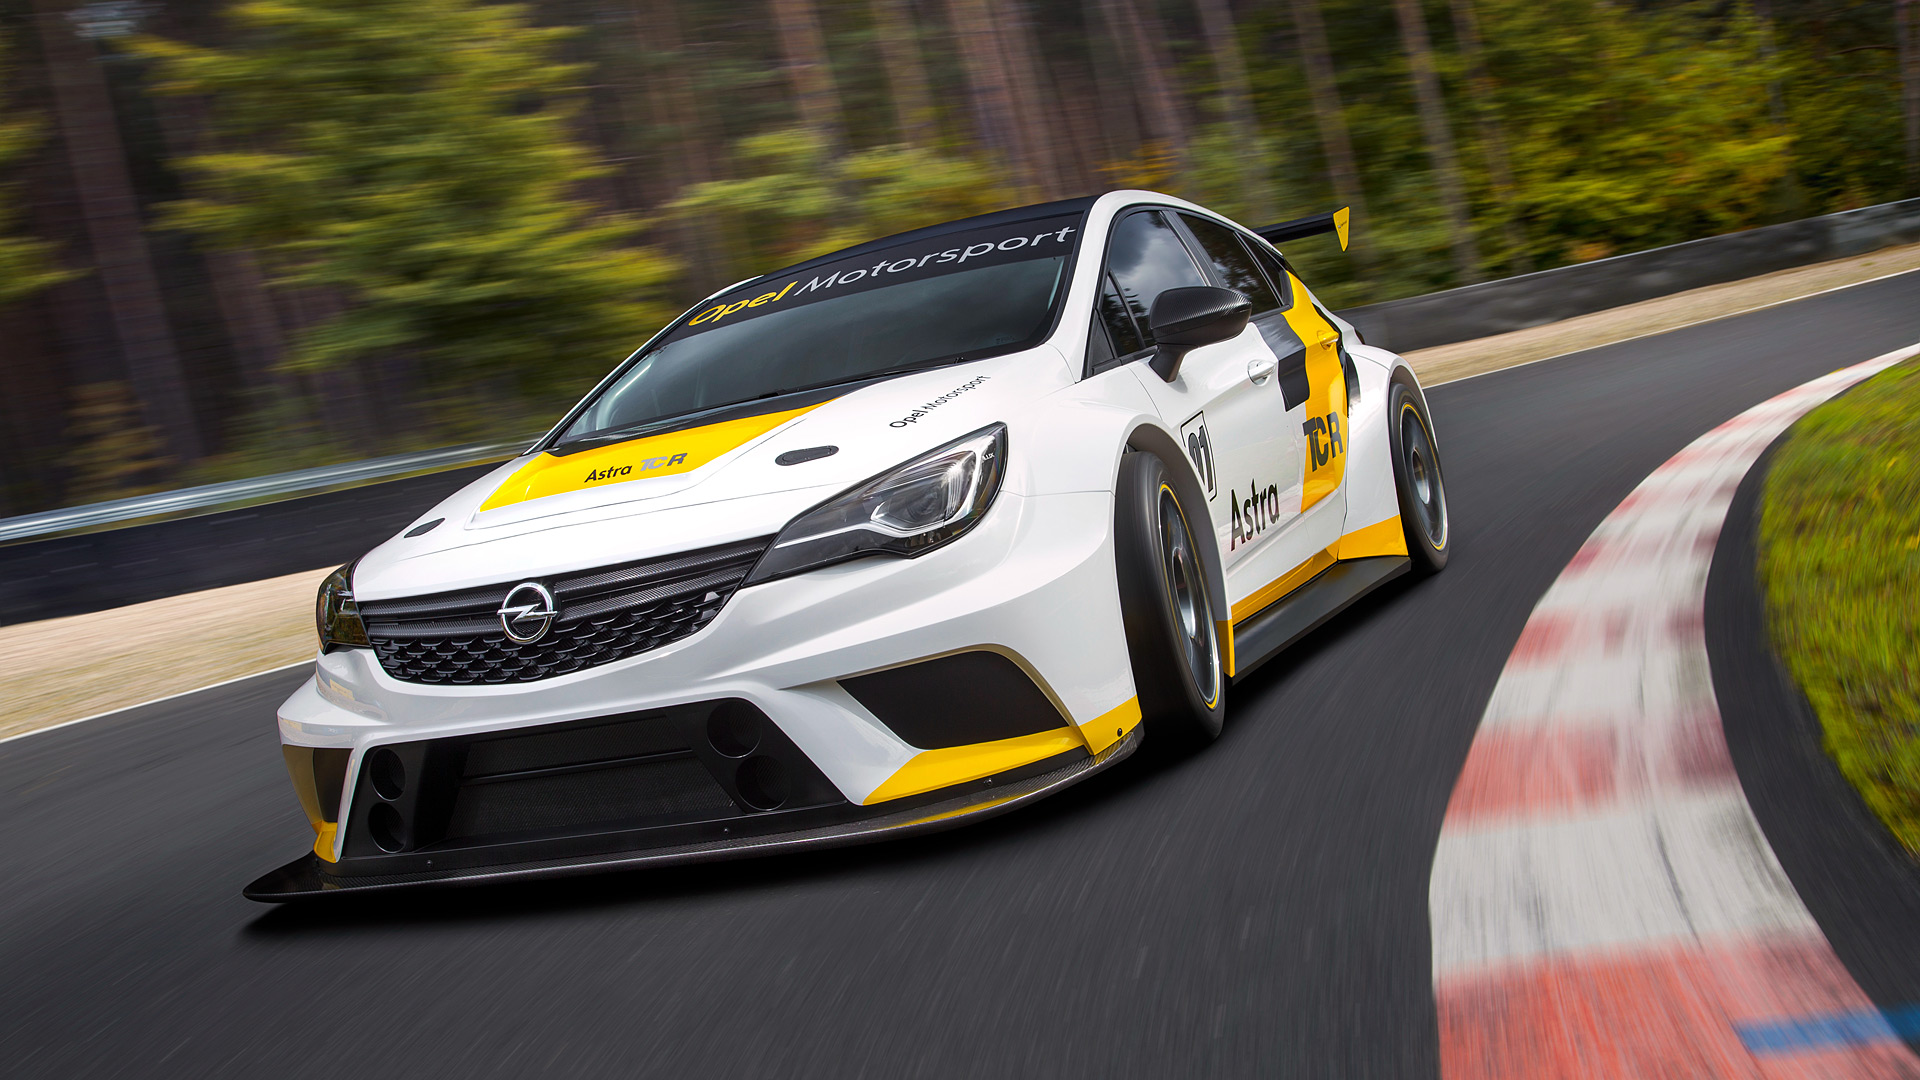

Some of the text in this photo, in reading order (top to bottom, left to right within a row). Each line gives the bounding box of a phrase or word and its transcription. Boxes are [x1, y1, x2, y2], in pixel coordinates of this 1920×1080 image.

[688, 225, 1077, 327] Opel Motorsport
[889, 375, 991, 428] Opel Motorsport
[584, 452, 688, 483] Astra TCR
[1302, 411, 1344, 472] TCR
[1230, 478, 1280, 552] Astra
